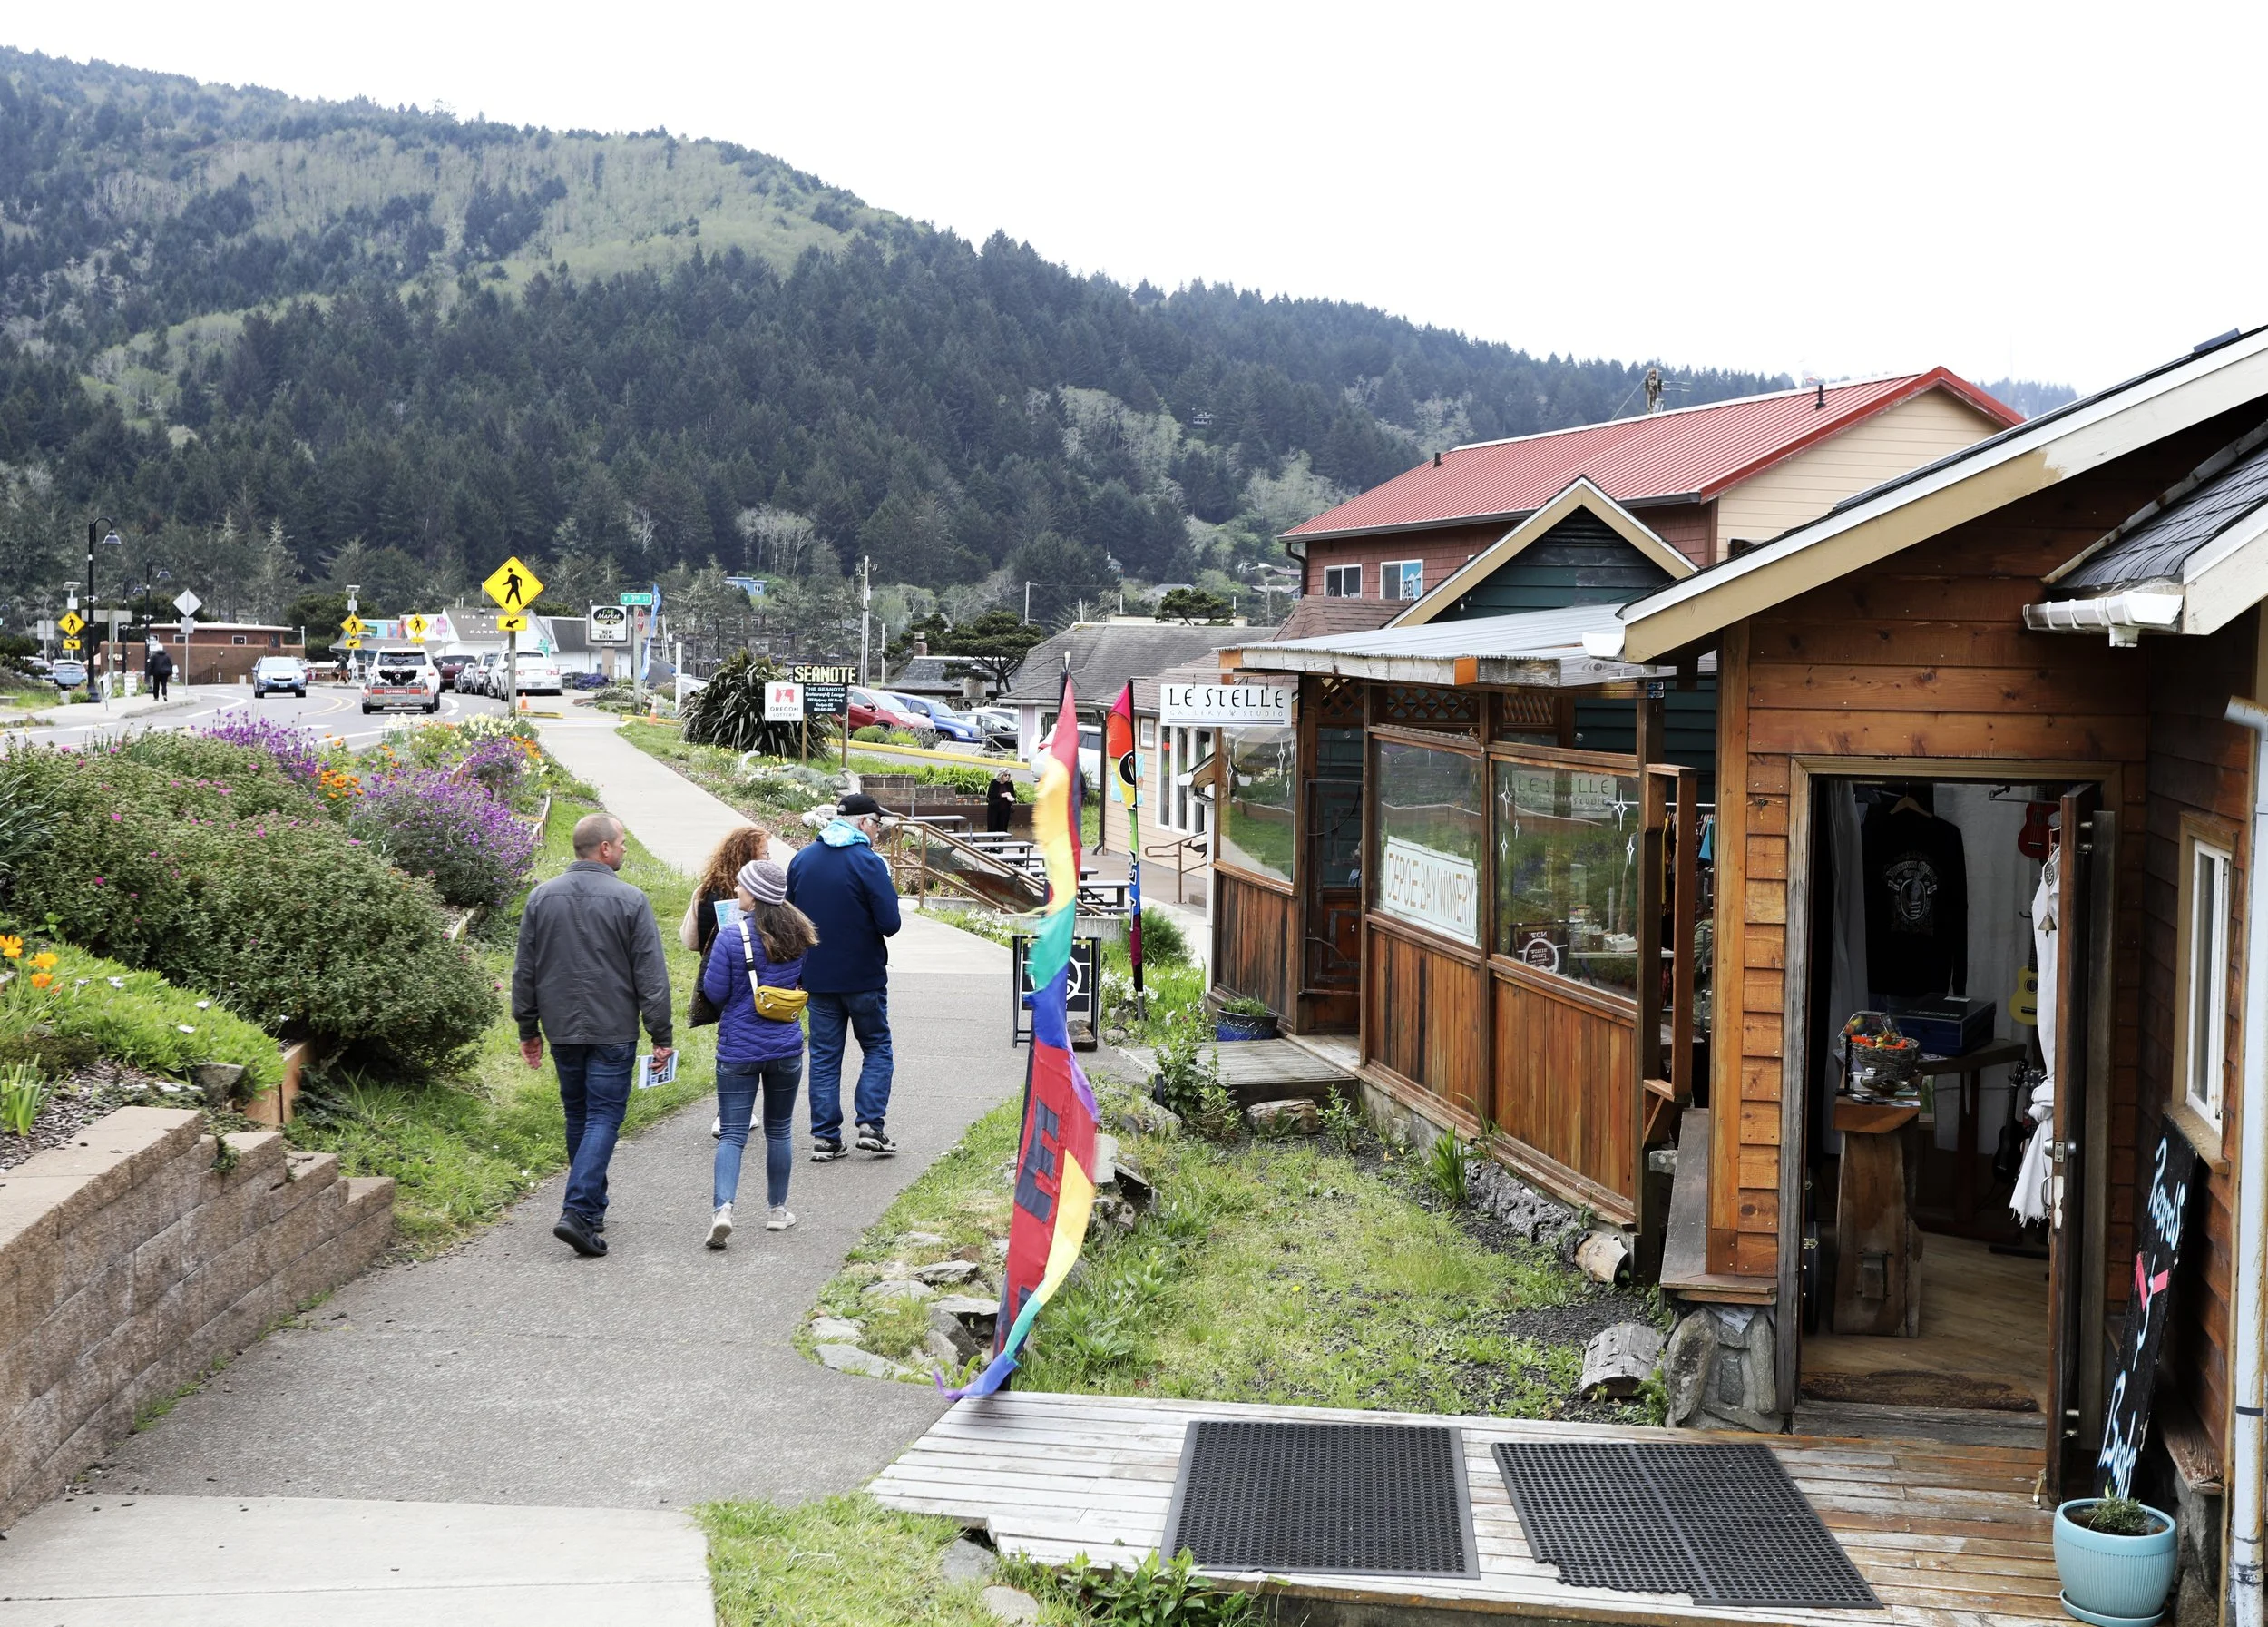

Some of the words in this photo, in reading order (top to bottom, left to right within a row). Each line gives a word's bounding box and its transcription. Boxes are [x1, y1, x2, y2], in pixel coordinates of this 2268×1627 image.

[794, 666, 856, 682] SEANOTE
[1170, 688, 1193, 707] LE
[1206, 689, 1284, 708] STELLE
[1388, 853, 1419, 907] DEPOE
[1421, 863, 1436, 913] BAY
[1438, 867, 1474, 926] WINERY
